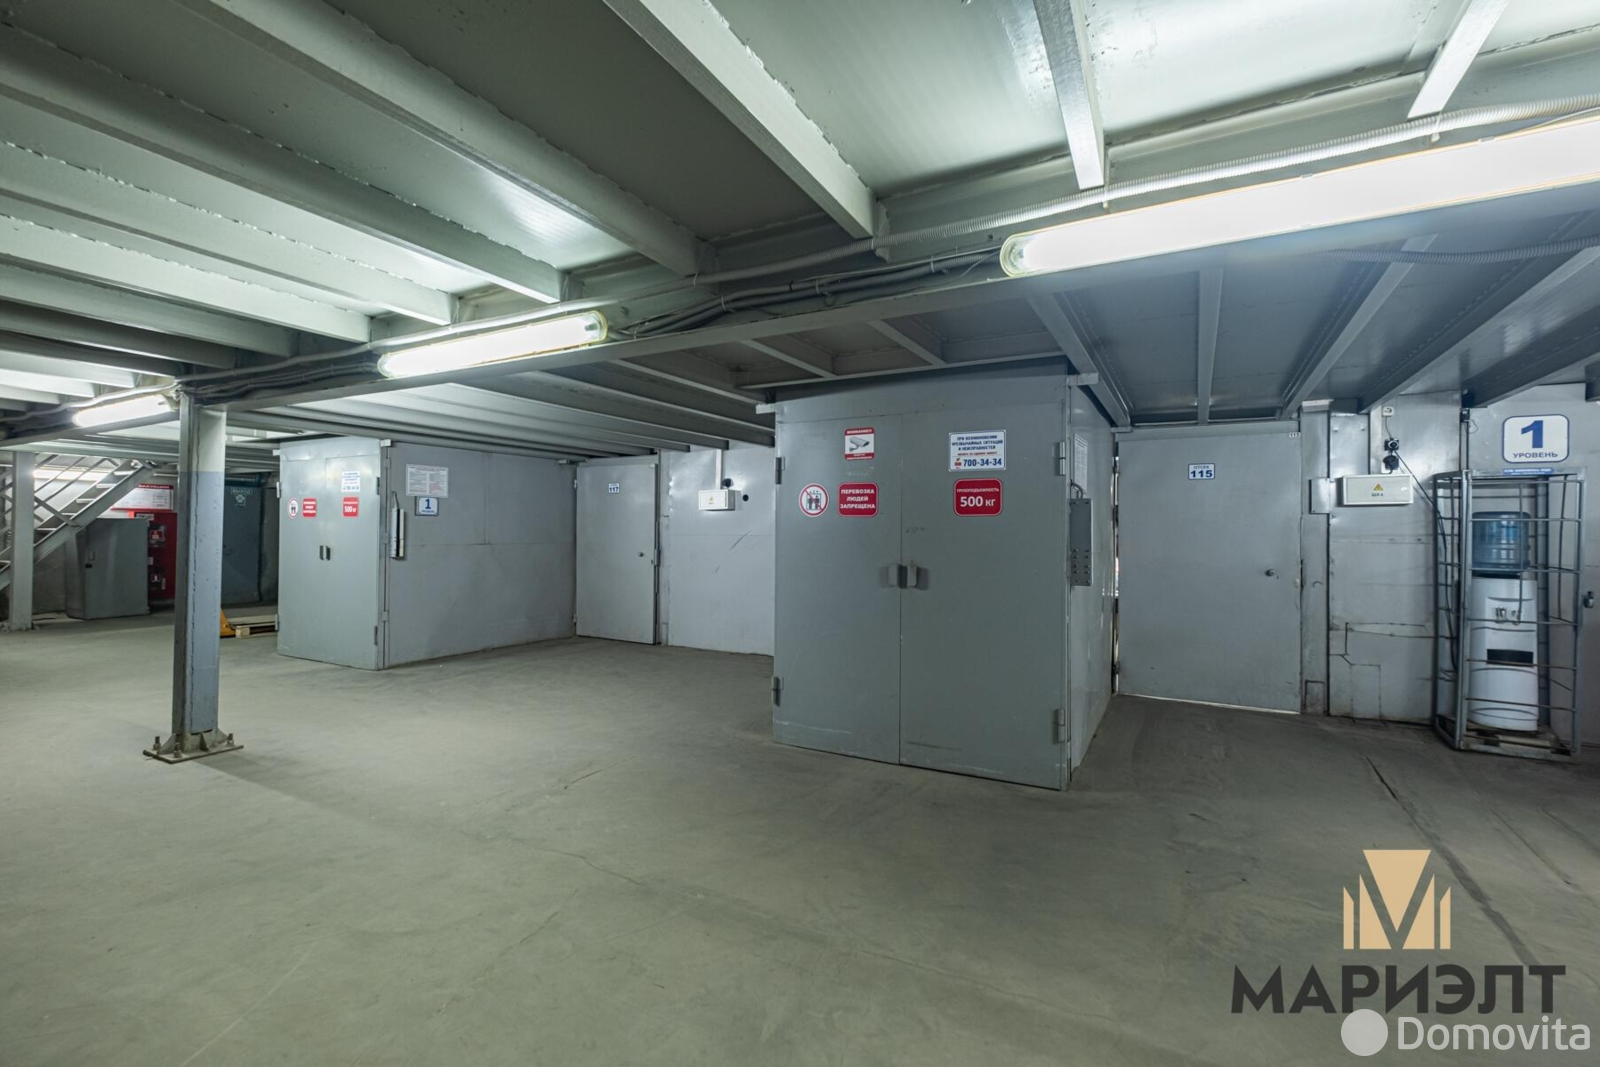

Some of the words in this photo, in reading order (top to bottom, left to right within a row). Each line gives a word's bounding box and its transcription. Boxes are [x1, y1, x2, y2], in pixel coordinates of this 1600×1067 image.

[1521, 419, 1544, 449] 1
[1512, 451, 1559, 459] УРОВЕНЬ
[963, 457, 1003, 467] 700-34-34
[1190, 469, 1213, 478] 115
[425, 498, 431, 510] 1
[960, 495, 984, 508] 500
[984, 498, 996, 507] кг
[344, 505, 353, 513] 500
